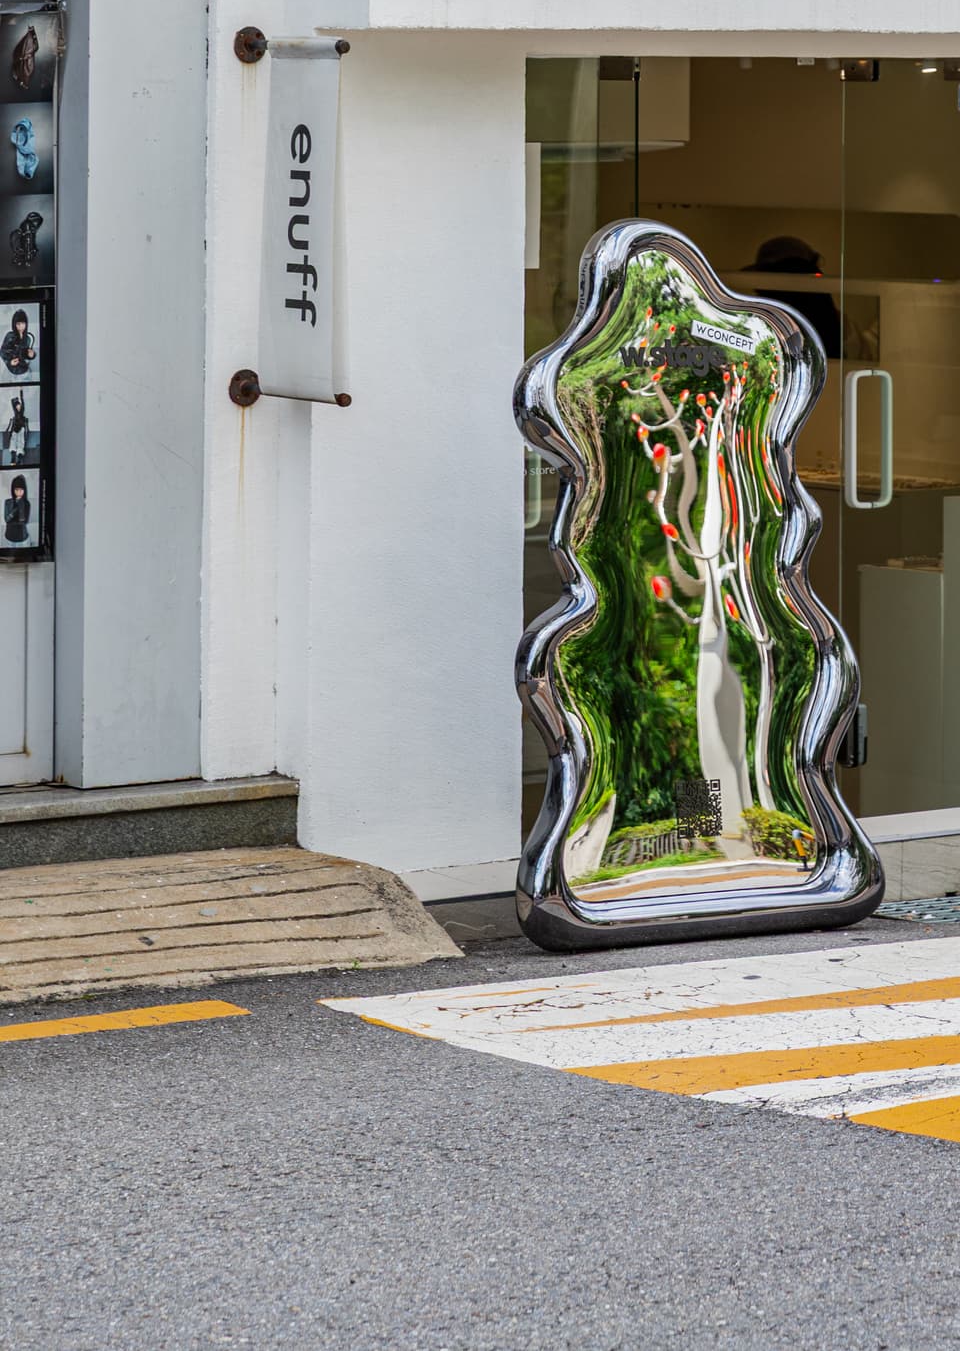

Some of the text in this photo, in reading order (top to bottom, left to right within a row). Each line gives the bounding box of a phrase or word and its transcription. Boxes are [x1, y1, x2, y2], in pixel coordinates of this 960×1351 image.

[285, 124, 318, 329] enuff
[620, 339, 726, 377] w.stage
[529, 466, 556, 475] store
